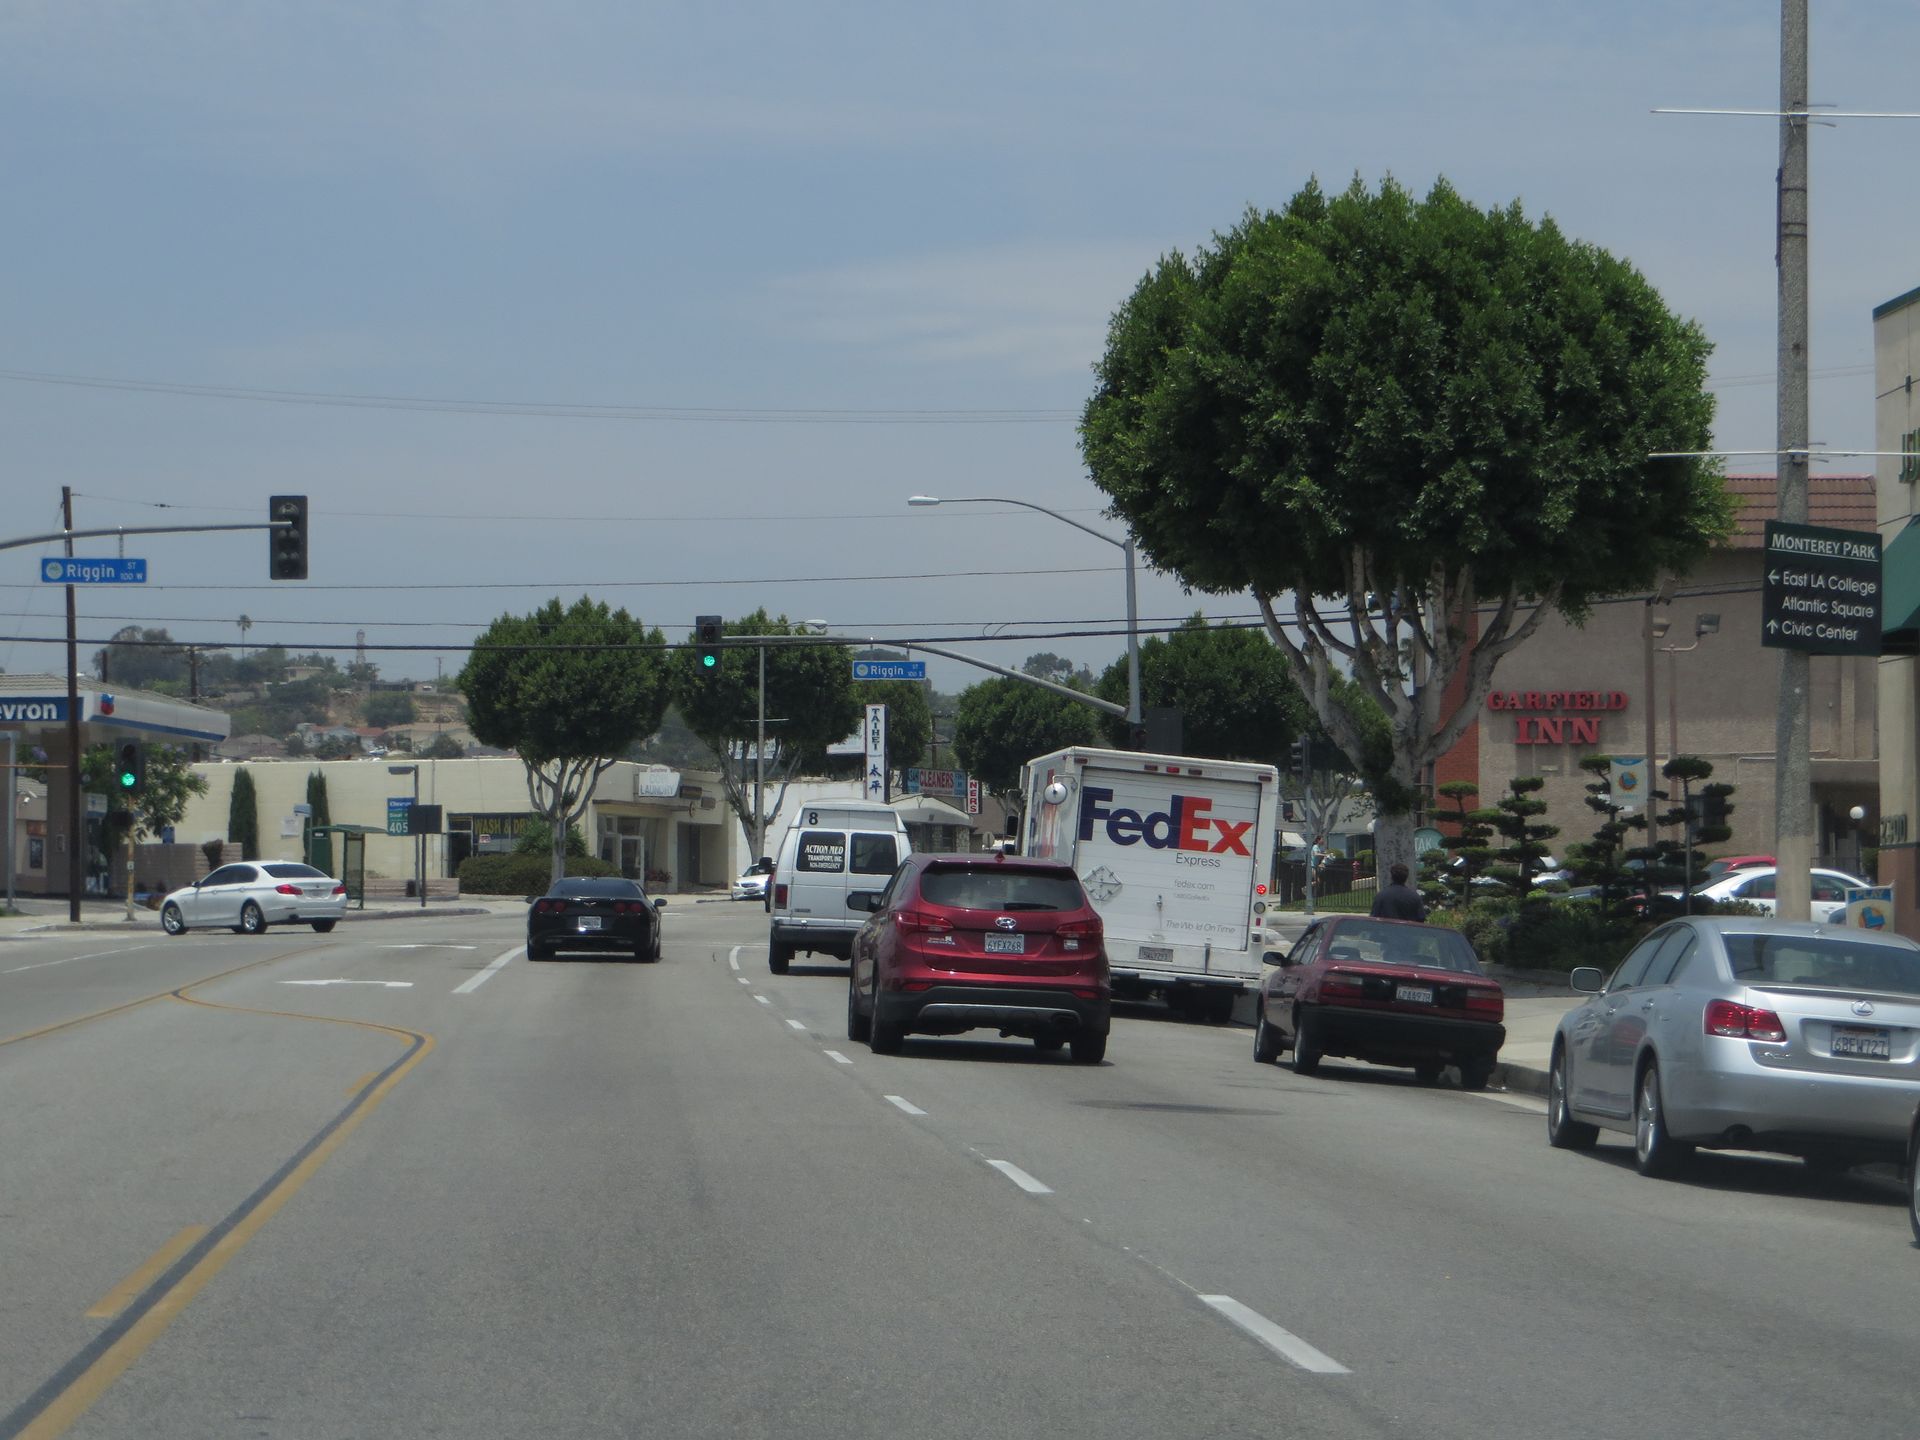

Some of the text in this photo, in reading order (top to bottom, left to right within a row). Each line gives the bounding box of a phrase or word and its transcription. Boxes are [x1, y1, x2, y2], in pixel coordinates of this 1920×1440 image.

[1771, 533, 1876, 559] MONTEREY PARK
[66, 564, 115, 582] Riggin
[1783, 571, 1876, 597] East LA College
[1782, 596, 1874, 618] Atlantic Square
[1781, 620, 1858, 641] Civic Center
[870, 665, 904, 678] Riggin
[1487, 691, 1629, 711] GARFIELD
[871, 708, 880, 751] TAIHEI
[1515, 716, 1601, 745] INN
[920, 769, 954, 788] CLEANERS
[640, 784, 676, 795] LAUNDRY
[474, 819, 500, 834] WASH
[503, 819, 510, 834] &
[808, 812, 818, 825] 8
[1079, 786, 1254, 856] FedEx
[804, 844, 828, 854] ACTION
[1175, 852, 1221, 868] Express
[1174, 879, 1215, 891] fedex.com
[1166, 919, 1236, 934] The Wold On Time
